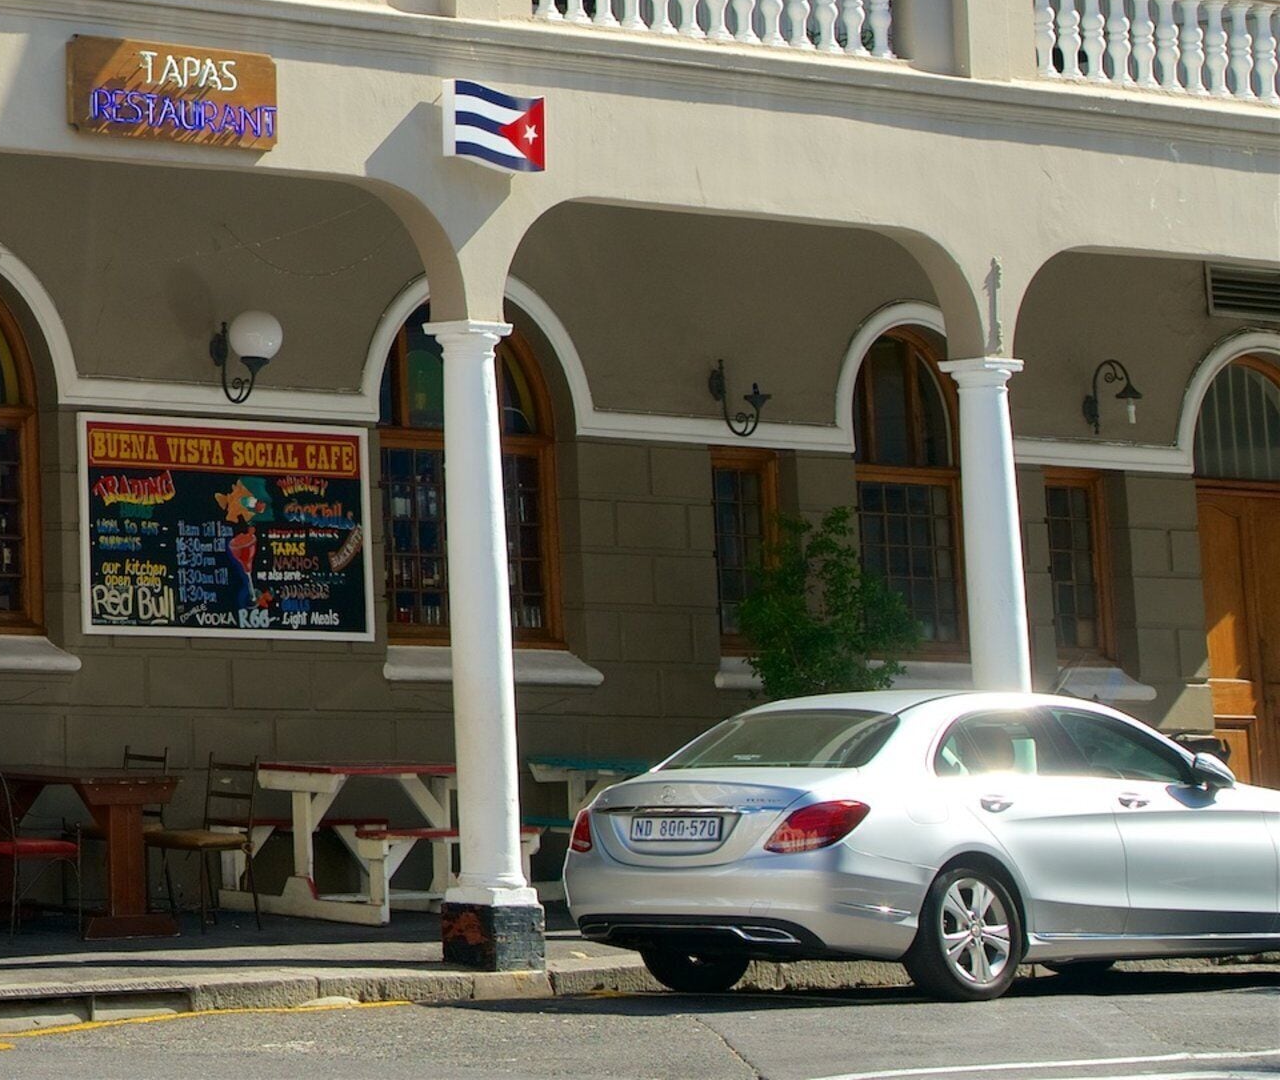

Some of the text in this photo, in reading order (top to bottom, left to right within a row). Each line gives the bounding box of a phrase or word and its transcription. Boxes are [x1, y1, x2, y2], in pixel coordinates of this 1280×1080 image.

[139, 50, 238, 92] TAPAS
[90, 88, 278, 138] RESTAURANT
[92, 431, 354, 470] BUENA VISTA SOCIAL CAFE
[92, 470, 177, 507] TRADING
[270, 541, 307, 557] TAPAS
[101, 558, 168, 578] our kitchen
[272, 557, 320, 571] NACHOS
[104, 573, 163, 593] open daily
[268, 569, 284, 581] also
[92, 584, 175, 621] Red Bull
[196, 612, 238, 626] VODKA
[281, 608, 340, 630] Light Meals
[634, 820, 653, 837] ND
